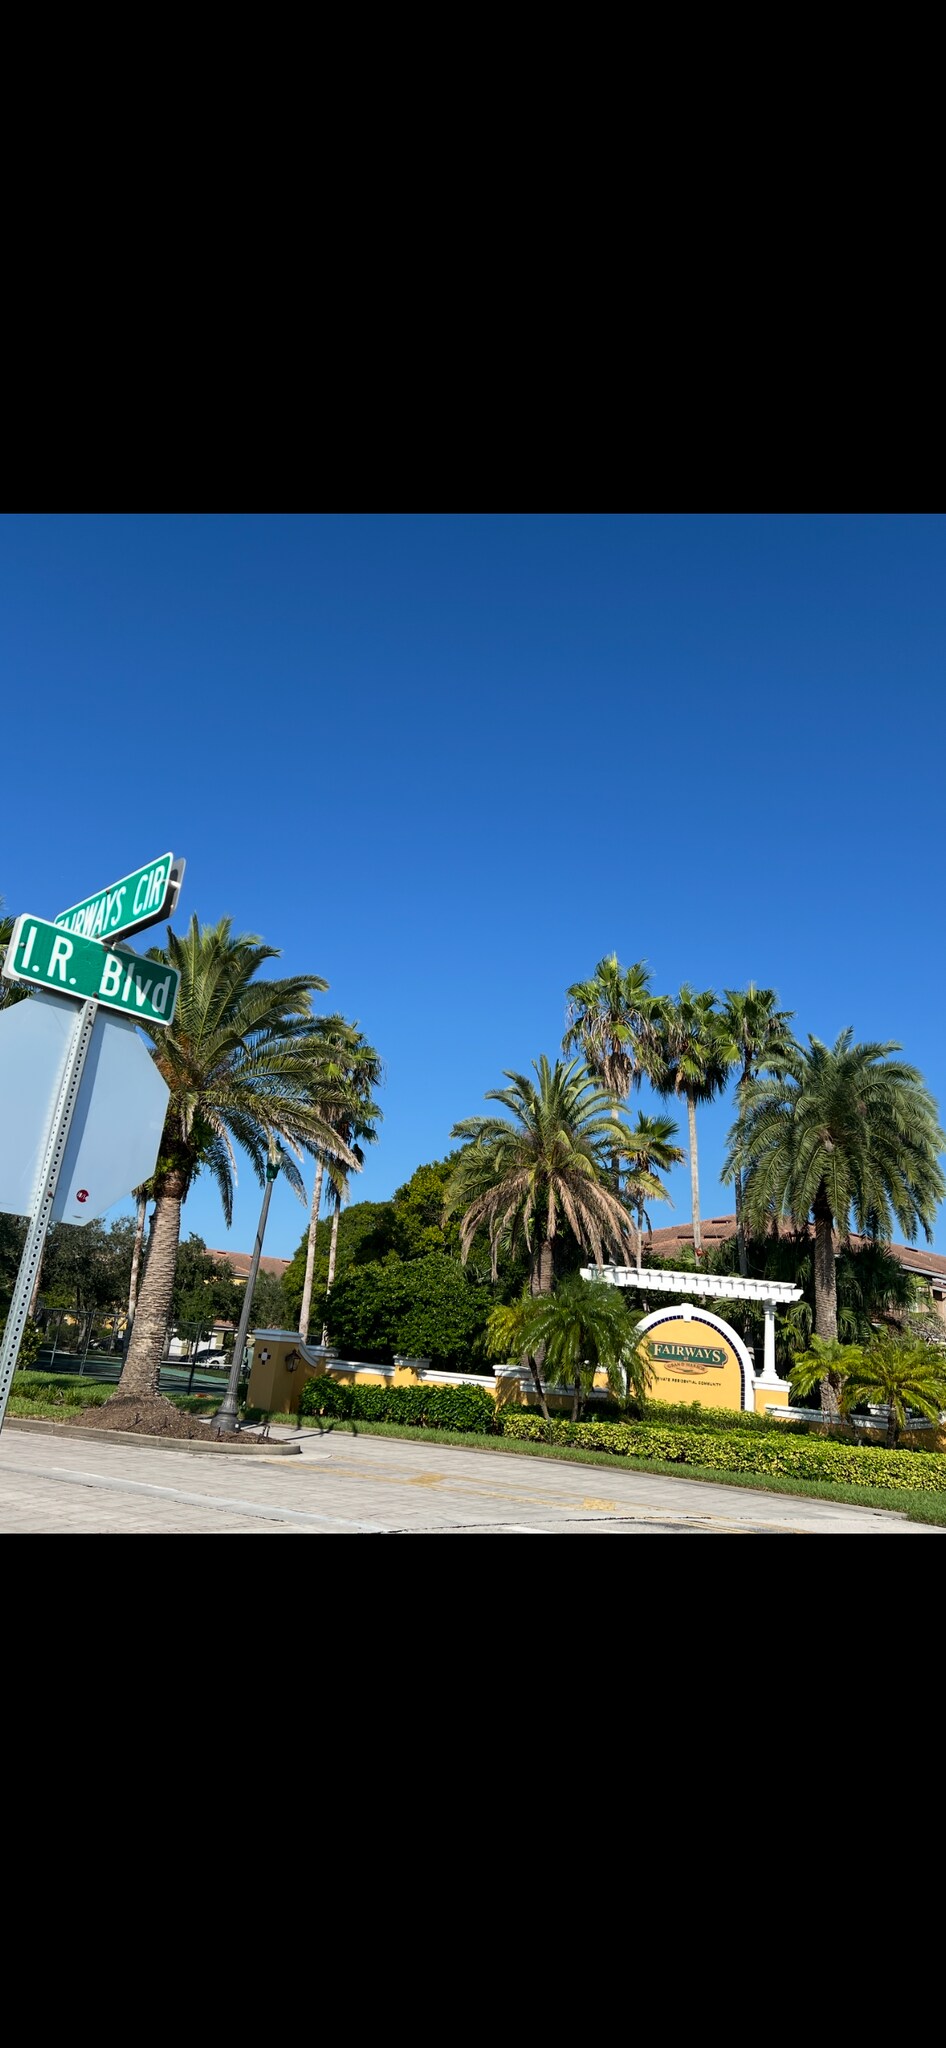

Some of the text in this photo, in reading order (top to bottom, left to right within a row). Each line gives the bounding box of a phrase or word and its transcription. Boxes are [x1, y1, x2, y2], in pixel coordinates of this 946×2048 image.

[56, 865, 166, 938] IRWAYS CIR
[99, 953, 172, 1014] Blvd
[653, 1344, 721, 1363] FAIRWAYS
